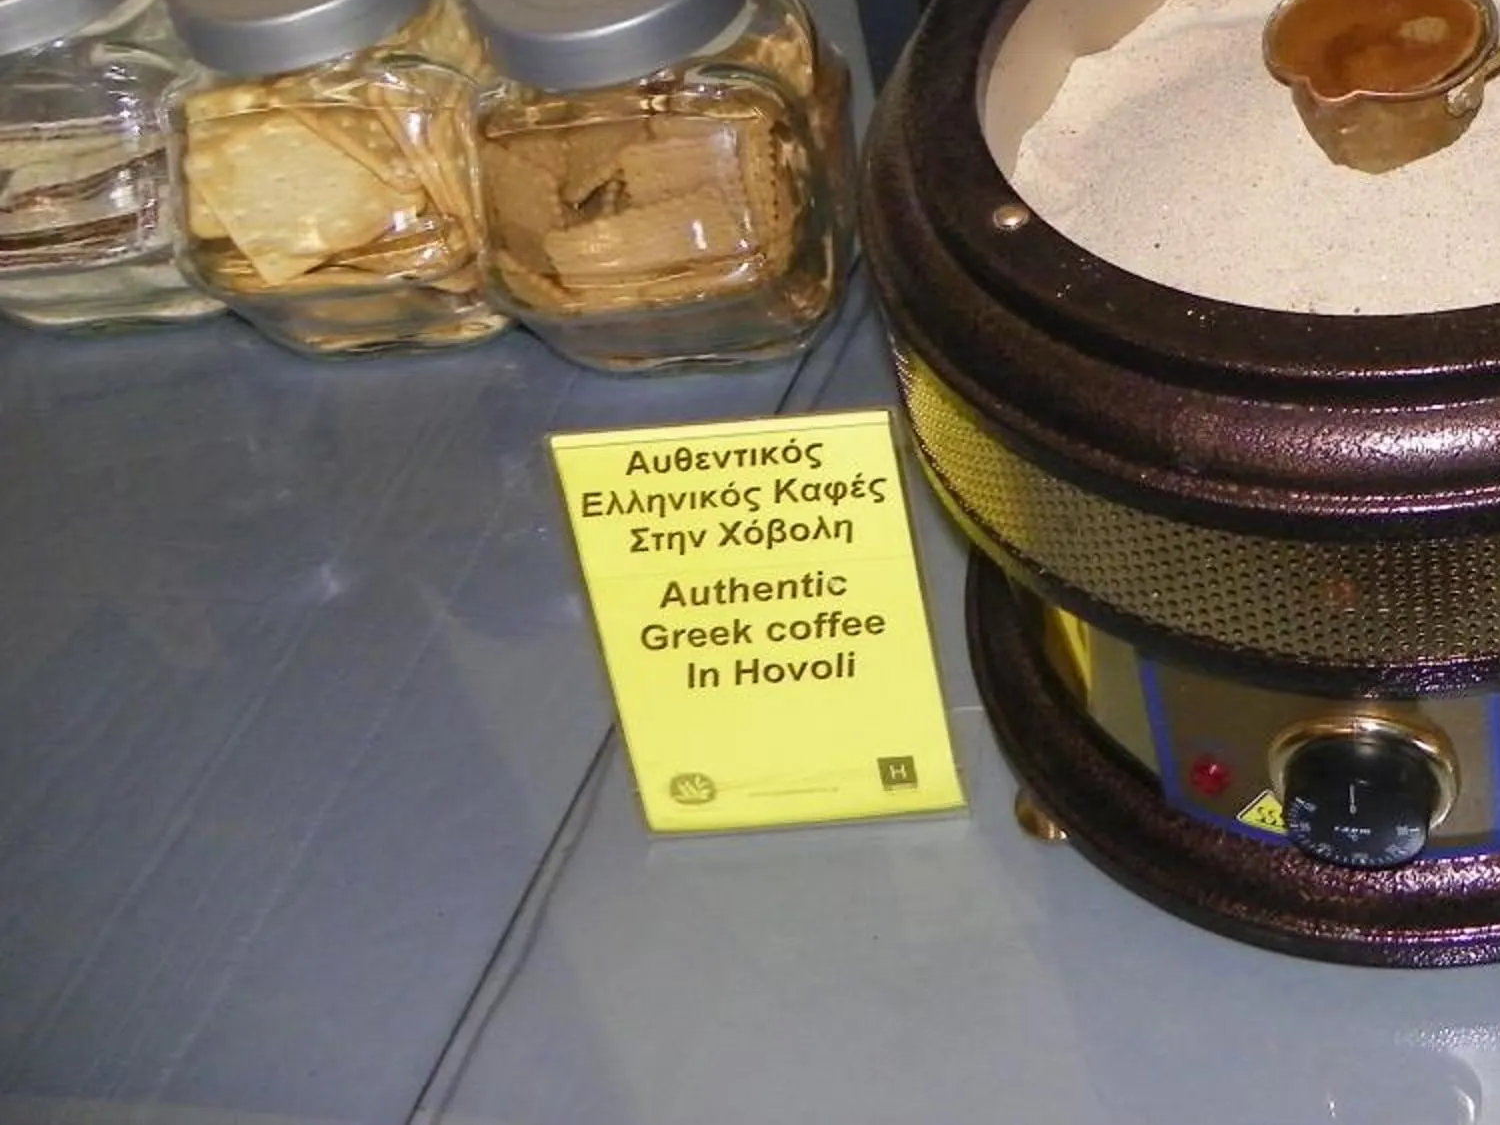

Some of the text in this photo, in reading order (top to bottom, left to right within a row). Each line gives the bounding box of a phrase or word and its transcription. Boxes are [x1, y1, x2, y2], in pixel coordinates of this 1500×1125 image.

[625, 438, 824, 476] Αυθεντικός
[581, 473, 888, 518] Ελληνικός Καφές
[629, 515, 854, 555] Στην Χόβολη
[658, 571, 848, 609] Authentic
[640, 611, 887, 652] Greek coffee
[686, 651, 856, 689] In Hovoli
